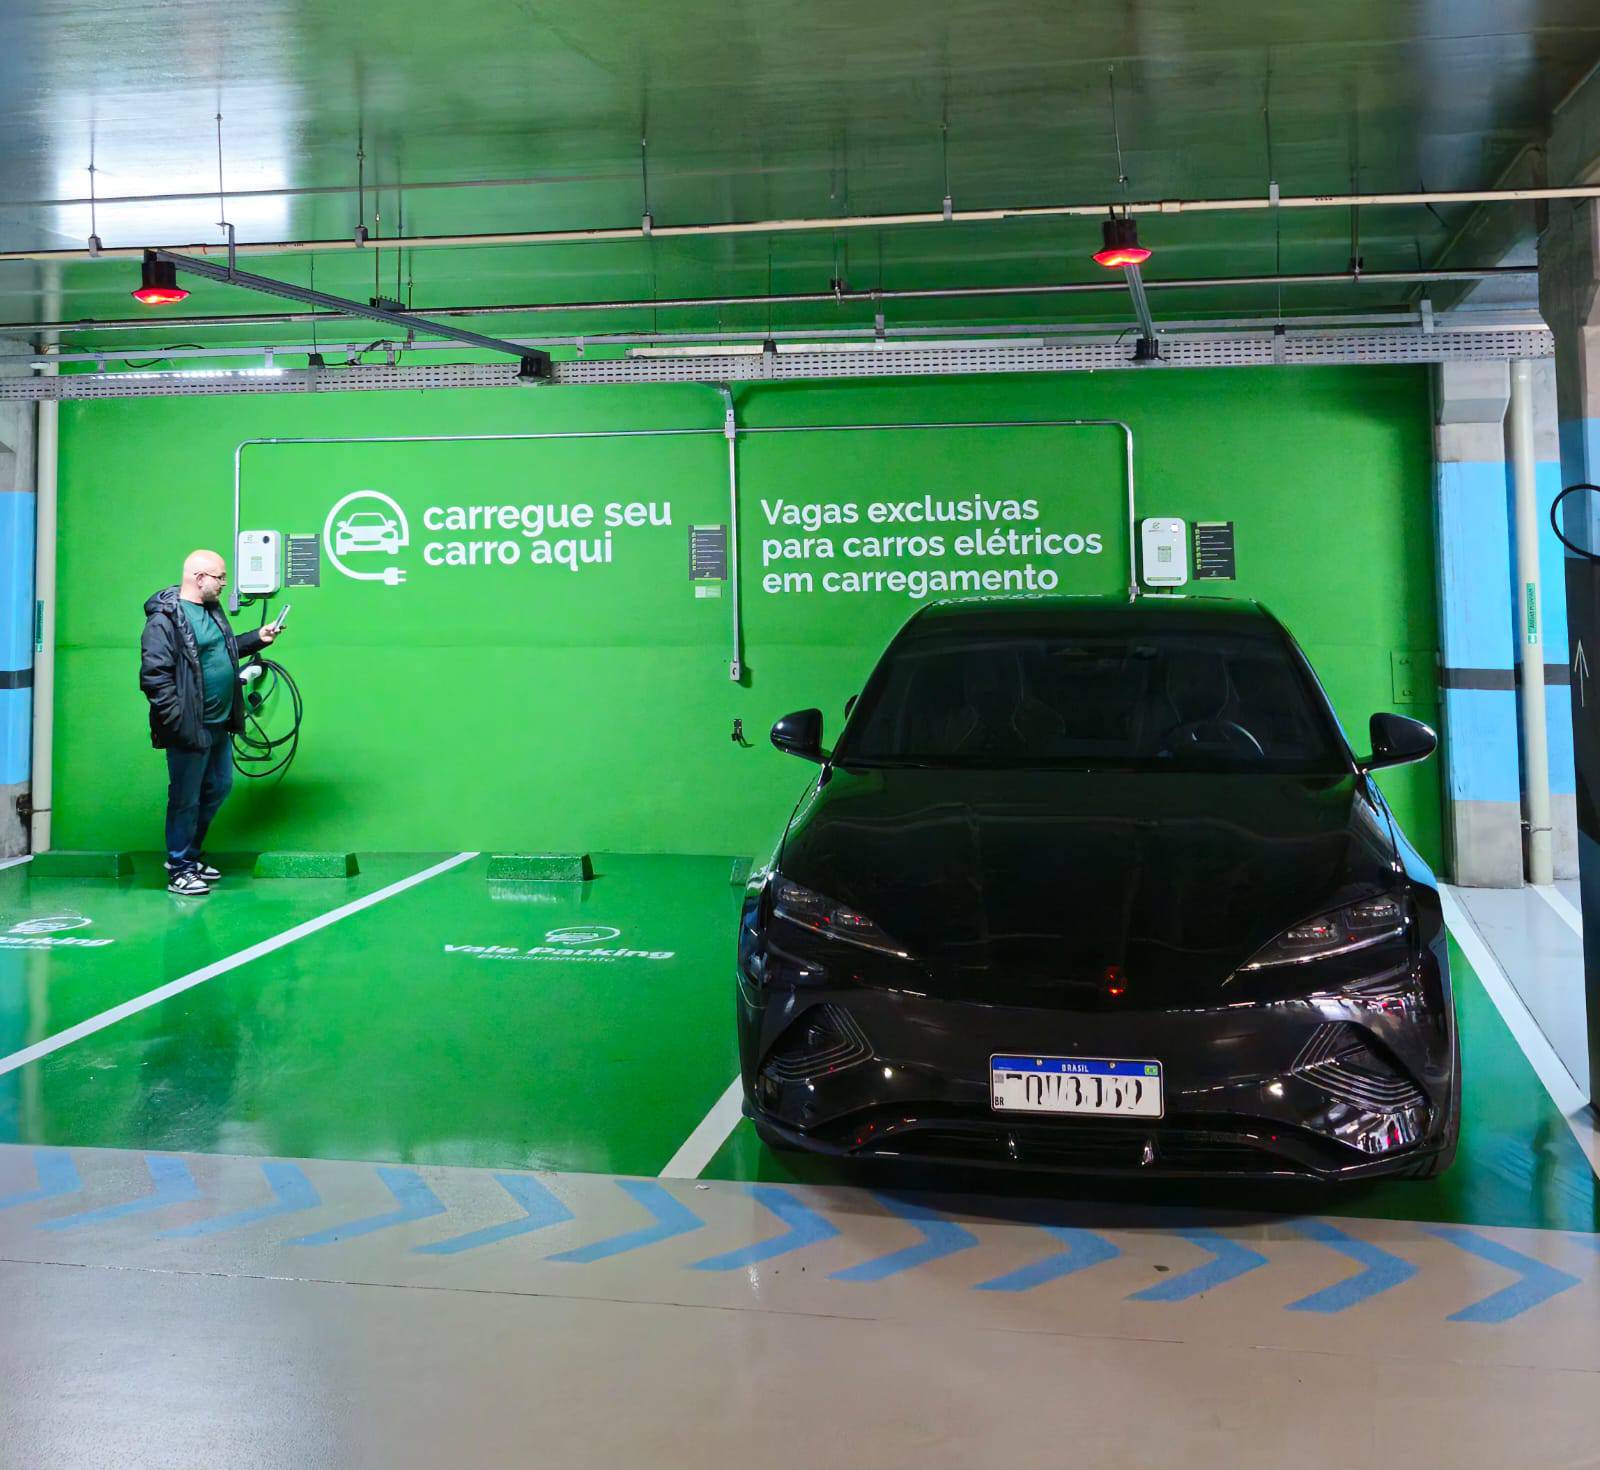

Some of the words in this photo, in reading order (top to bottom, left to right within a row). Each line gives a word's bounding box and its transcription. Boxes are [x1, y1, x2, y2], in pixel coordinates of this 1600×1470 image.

[423, 502, 594, 538] carregue
[604, 502, 672, 527] seu
[760, 500, 859, 532] Vagas
[867, 493, 1039, 523] exclusivas
[423, 539, 521, 566] carro
[530, 530, 612, 572] aqui
[762, 538, 834, 567] para
[843, 536, 945, 558] carros
[954, 527, 1103, 556] elétricos
[762, 572, 813, 594] em
[822, 564, 1058, 599] carregamento
[444, 944, 519, 953] Vale
[527, 946, 675, 960] Parking
[1061, 1063, 1089, 1073] BRASIL
